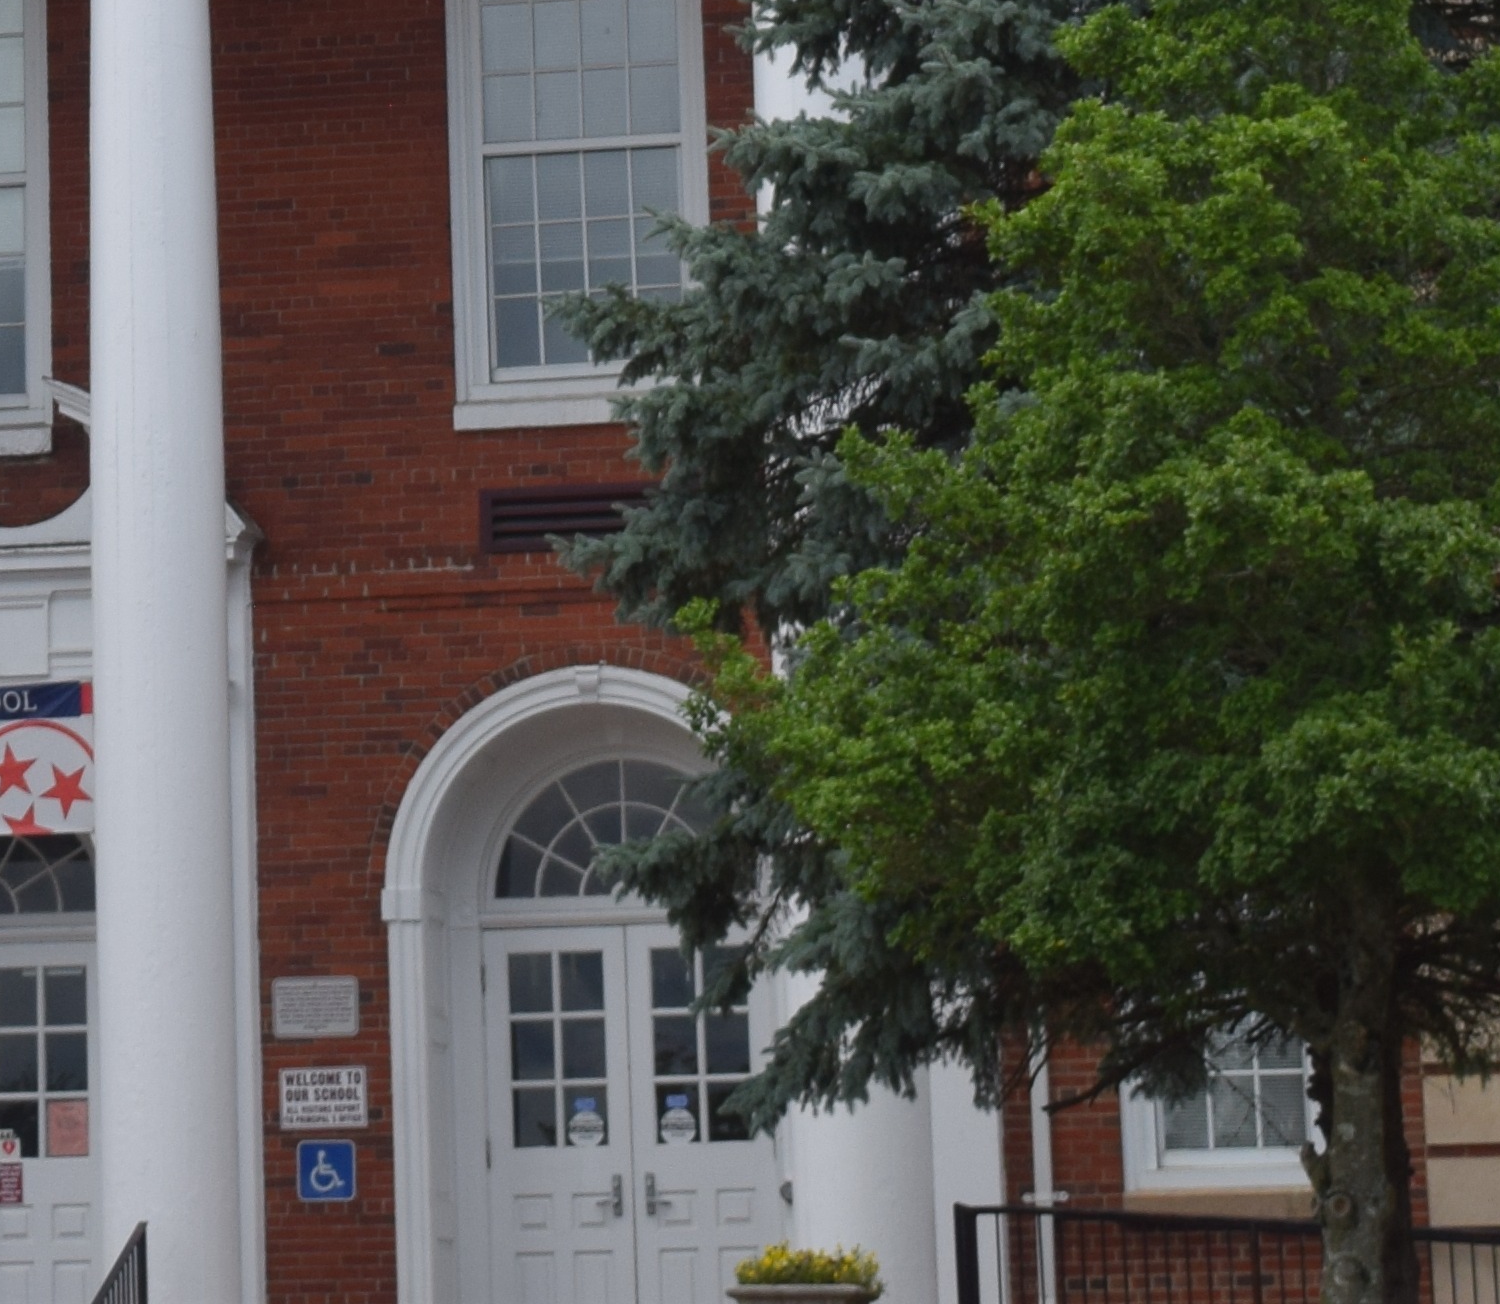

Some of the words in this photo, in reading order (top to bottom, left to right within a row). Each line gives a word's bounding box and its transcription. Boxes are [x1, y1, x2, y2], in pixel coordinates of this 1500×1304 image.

[285, 1071, 342, 1086] WELCOME
[347, 1070, 361, 1084] TO
[286, 1088, 309, 1102] OUR
[314, 1087, 360, 1101] SCHOOL
